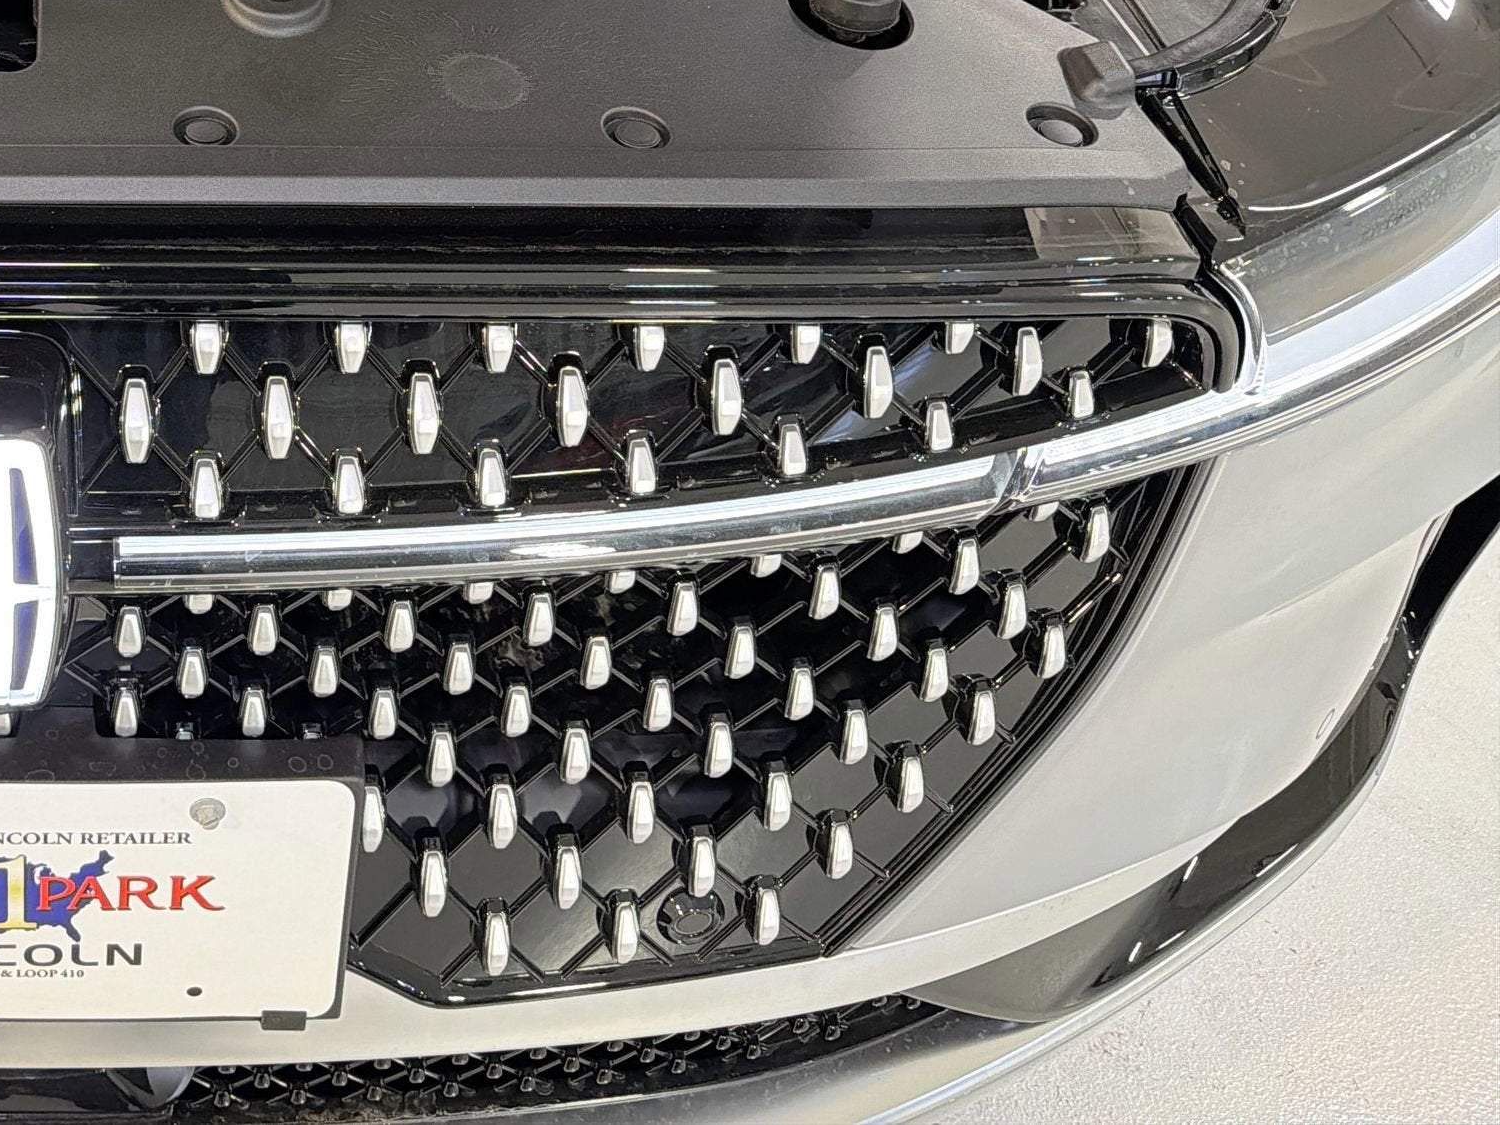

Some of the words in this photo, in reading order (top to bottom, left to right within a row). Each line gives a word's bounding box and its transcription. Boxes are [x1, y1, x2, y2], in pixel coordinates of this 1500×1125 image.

[81, 831, 193, 845] RETAILER
[36, 875, 226, 911] PARK
[0, 969, 13, 978] &
[16, 969, 59, 978] LOOP
[60, 969, 85, 978] 410
